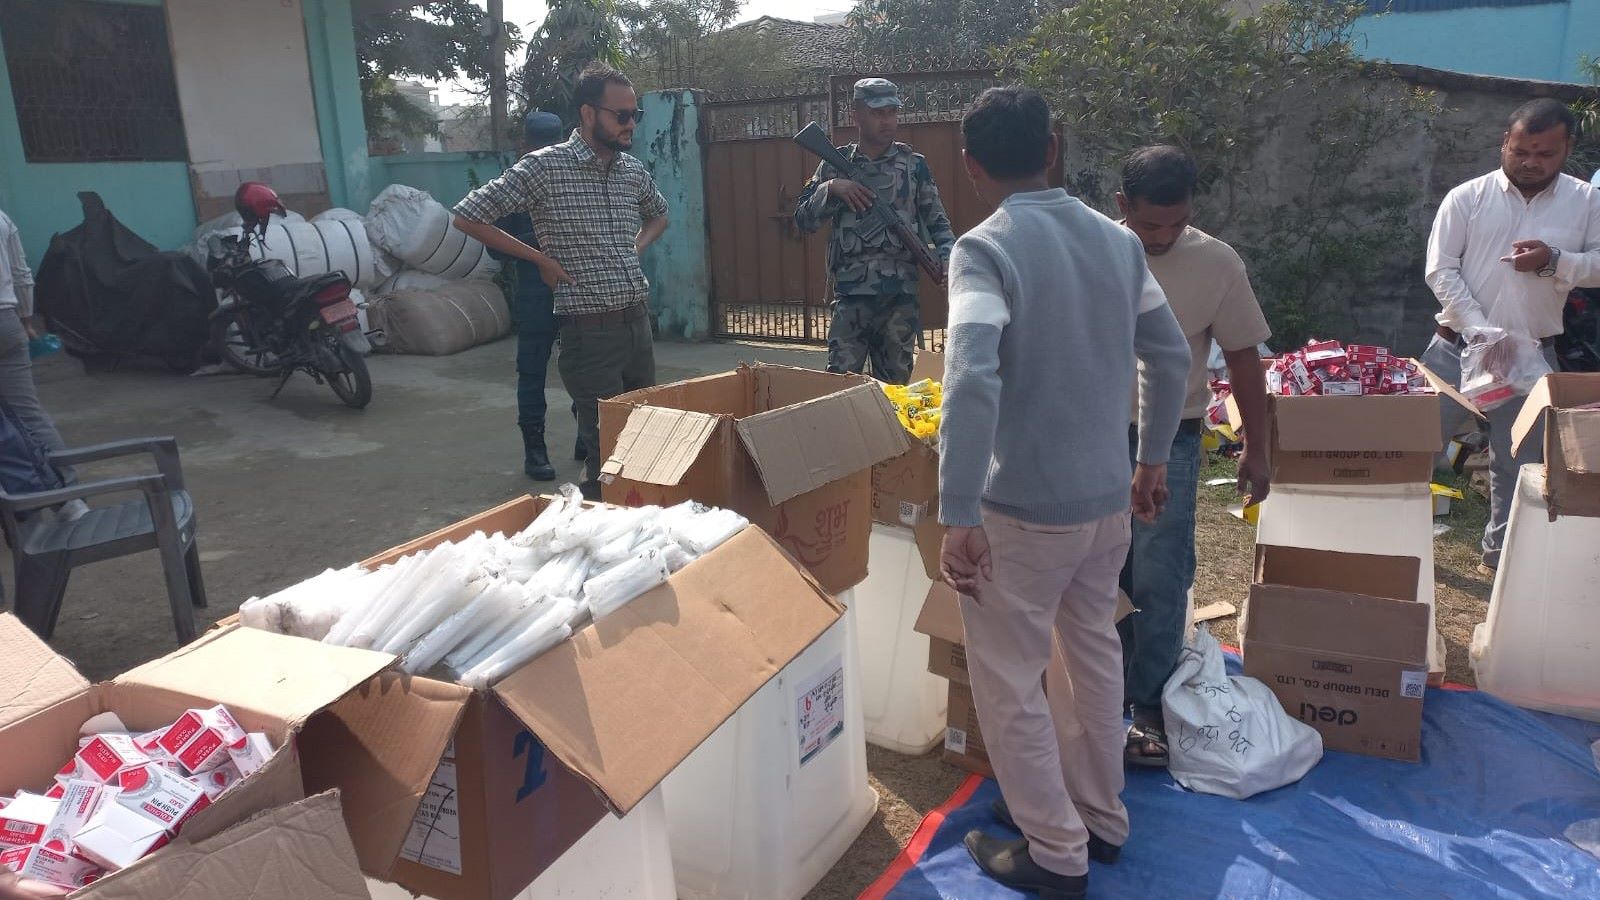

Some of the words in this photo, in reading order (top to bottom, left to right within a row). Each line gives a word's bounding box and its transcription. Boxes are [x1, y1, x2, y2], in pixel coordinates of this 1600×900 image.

[1323, 682, 1362, 696] GROUP
[1365, 687, 1391, 698] DELI
[1300, 701, 1358, 726] deli
[150, 797, 163, 808] PIN
[161, 803, 179, 817] PUSH
